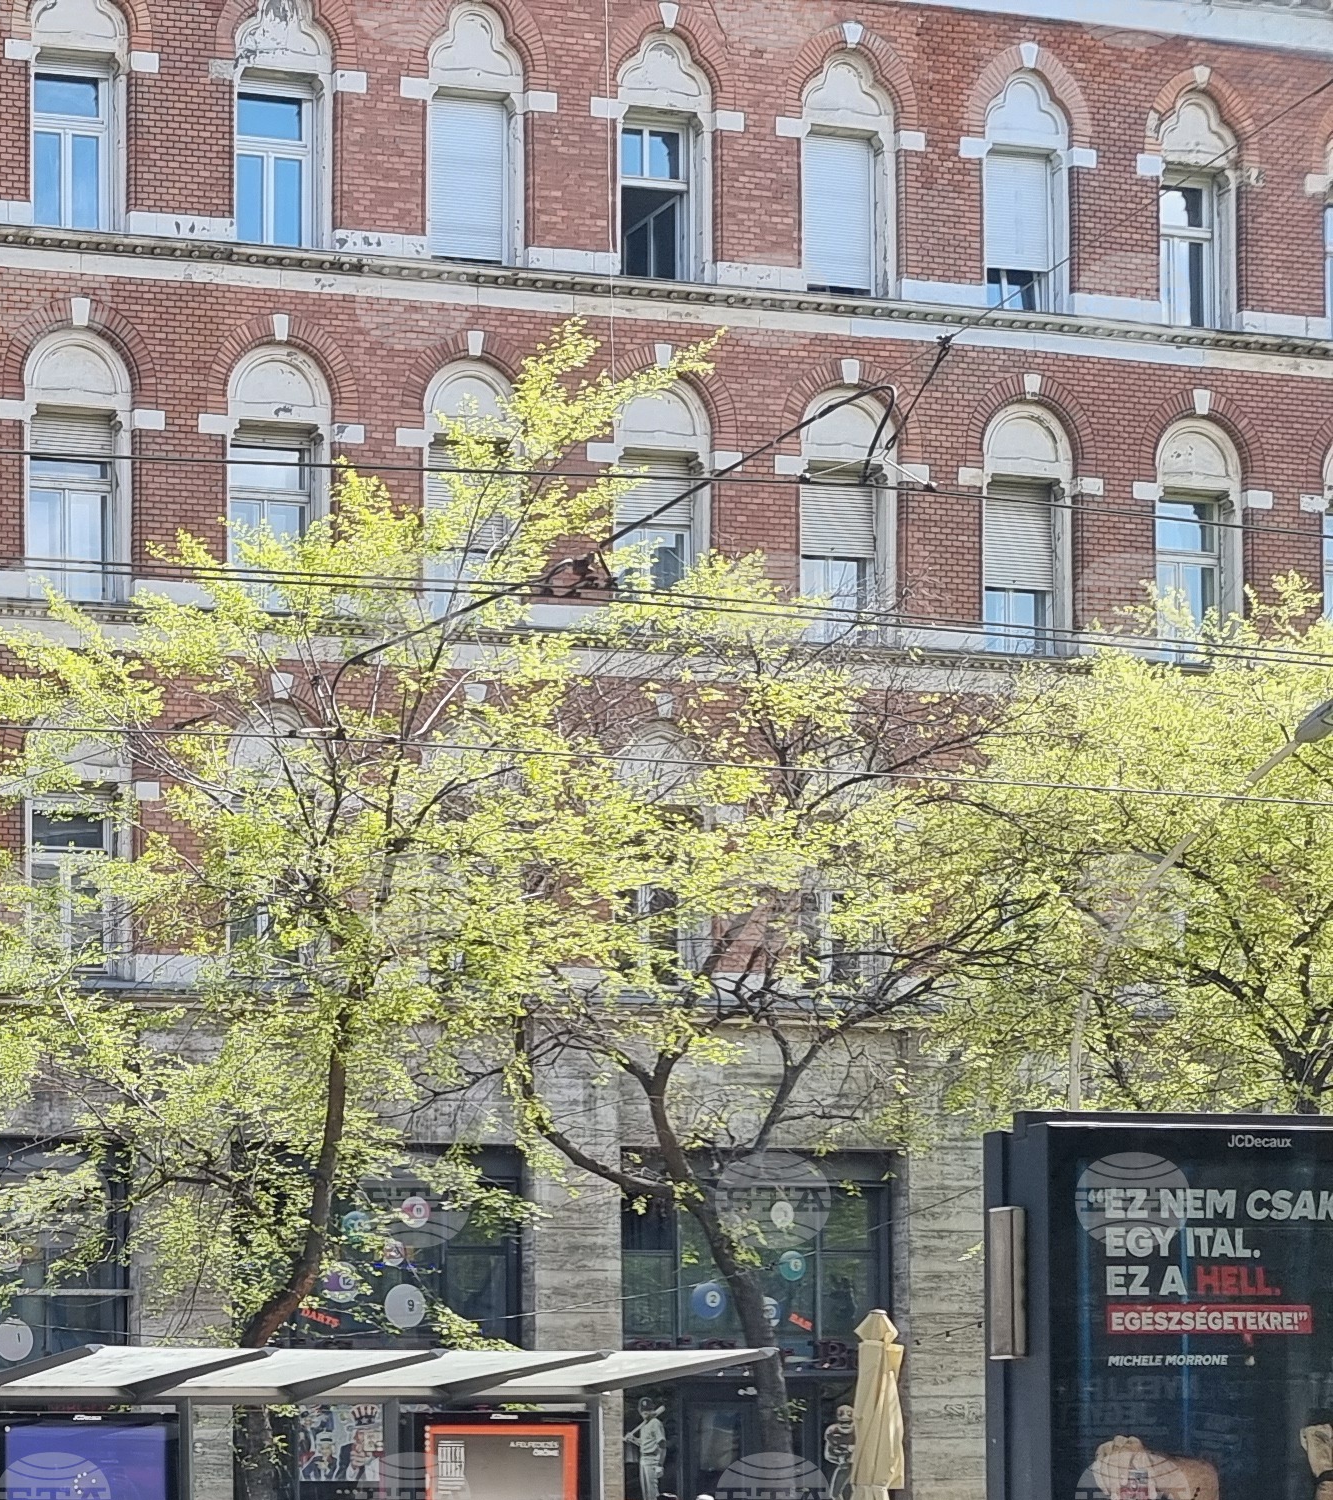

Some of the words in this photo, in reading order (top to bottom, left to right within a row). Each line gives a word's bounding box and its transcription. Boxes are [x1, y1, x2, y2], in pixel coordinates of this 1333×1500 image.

[1227, 1135, 1292, 1149] JCDecaux
[1159, 1188, 1236, 1220] NEM
[1106, 1227, 1178, 1257] EGY
[1186, 1228, 1261, 1258] ITAL.
[1106, 1265, 1150, 1296] EZ
[1159, 1265, 1188, 1296] A
[1196, 1265, 1282, 1296] HELL.
[1108, 1354, 1163, 1367] MICHELE
[1164, 1354, 1229, 1366] MORRONE
